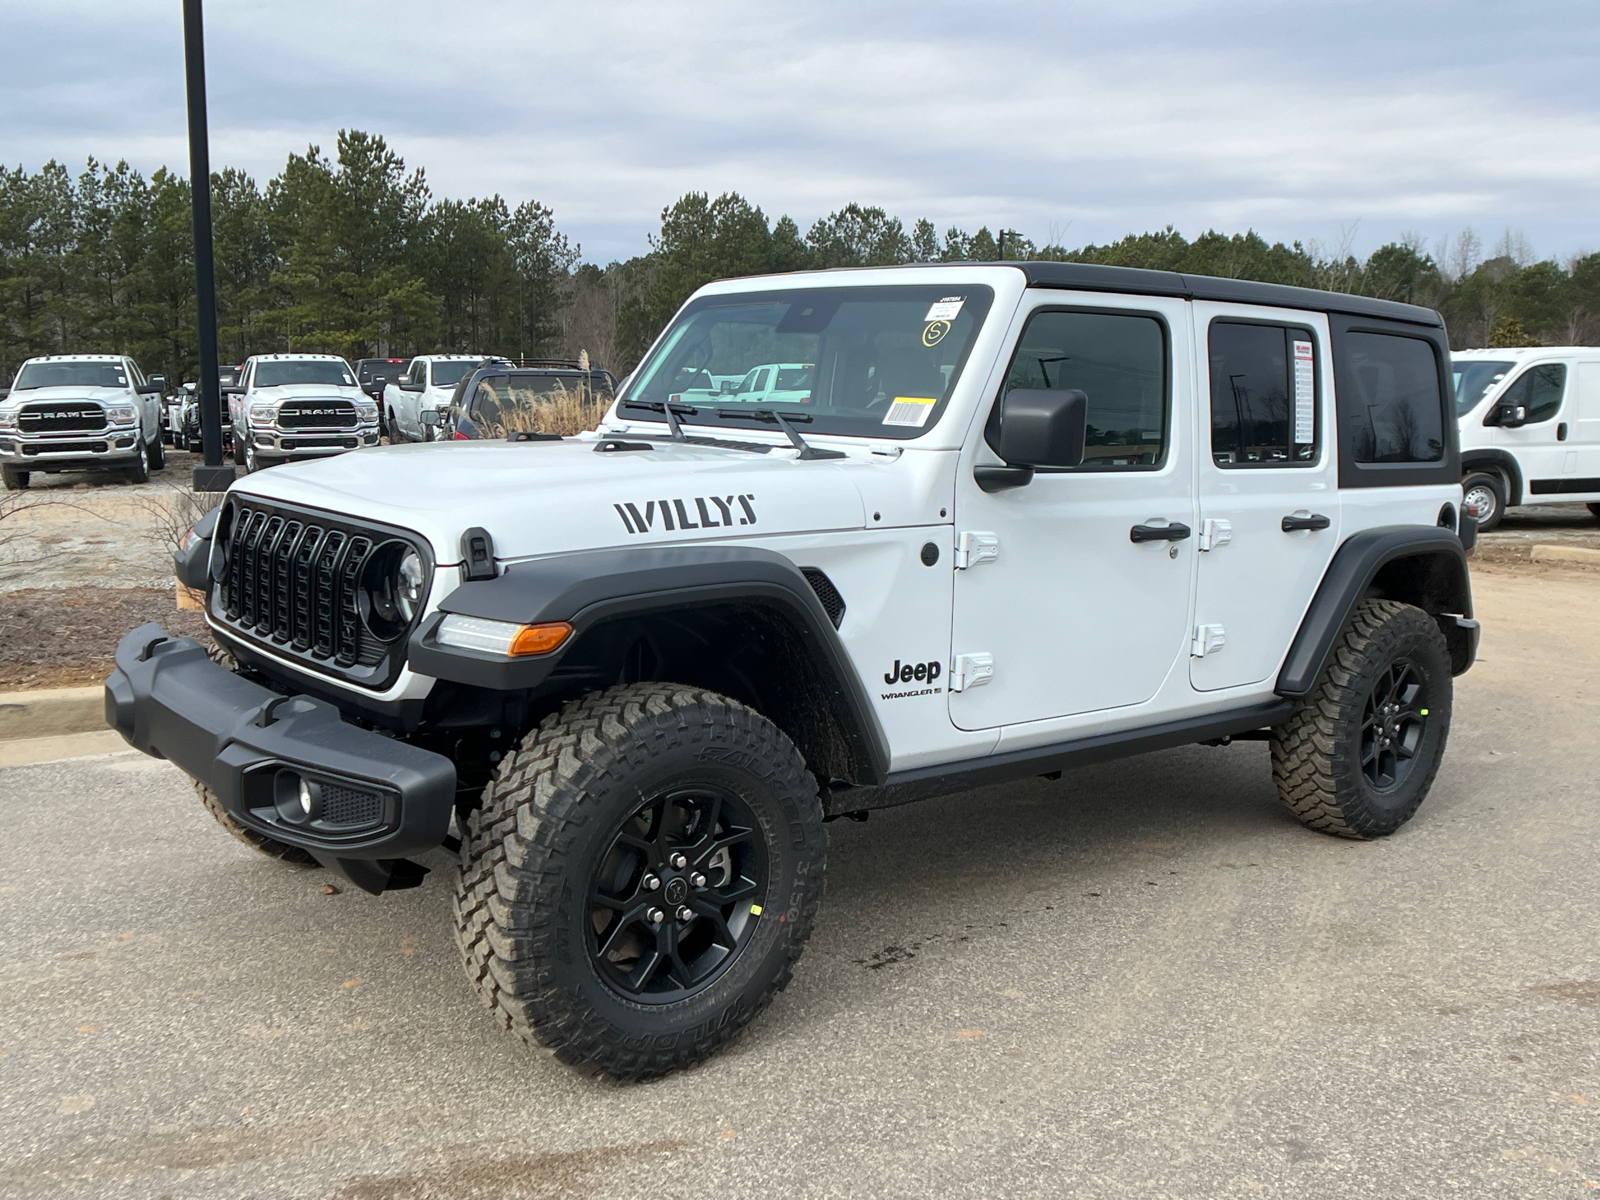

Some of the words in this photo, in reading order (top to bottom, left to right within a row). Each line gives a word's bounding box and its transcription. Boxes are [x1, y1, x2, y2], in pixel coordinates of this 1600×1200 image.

[929, 323, 941, 340] S
[43, 411, 80, 419] RAM
[613, 494, 757, 534] WILLYS
[884, 660, 941, 685] Jeep
[881, 689, 933, 700] WRANGLER
